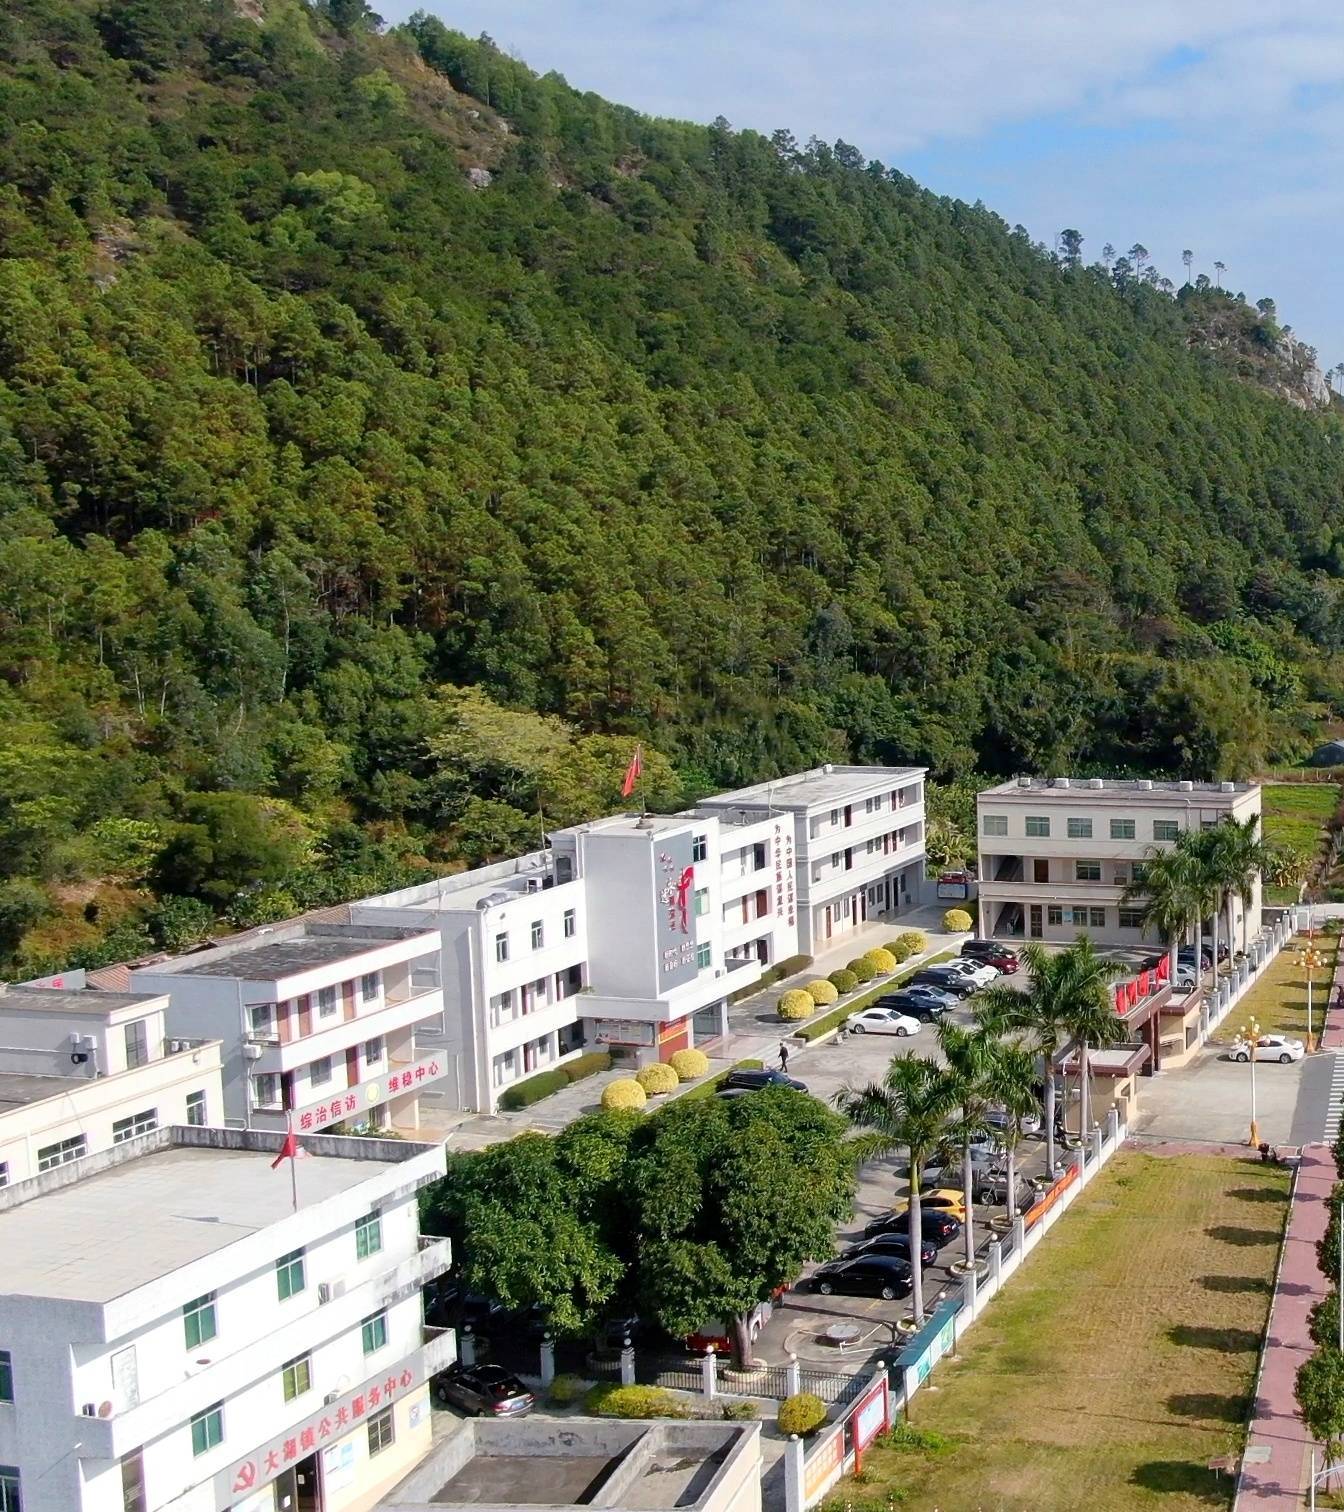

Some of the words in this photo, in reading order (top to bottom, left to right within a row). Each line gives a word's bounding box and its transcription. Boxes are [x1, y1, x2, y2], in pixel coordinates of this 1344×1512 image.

[300, 1094, 357, 1130] 综治信访
[387, 1062, 440, 1093] 维稳中心
[264, 1369, 413, 1476] 大湖镇公共服务中心
